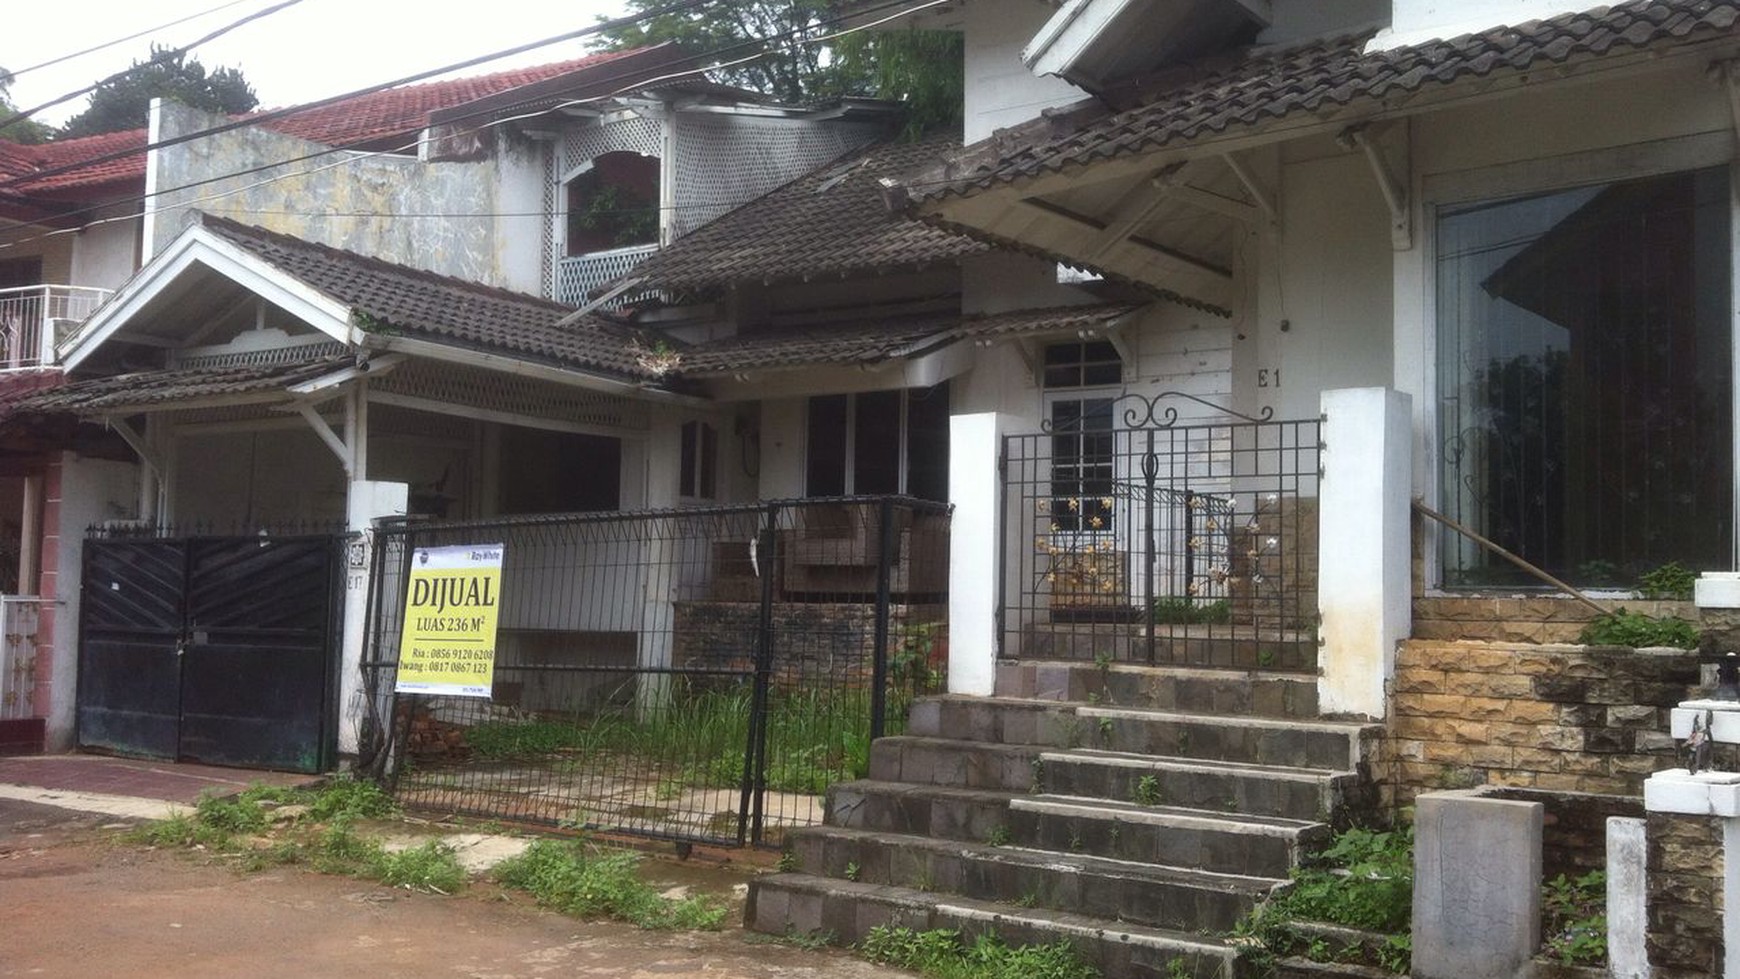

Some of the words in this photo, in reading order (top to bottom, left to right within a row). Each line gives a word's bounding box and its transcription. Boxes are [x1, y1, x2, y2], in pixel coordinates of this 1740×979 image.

[1258, 368, 1281, 388] E1
[411, 576, 495, 613] DIJUAL
[416, 617, 446, 632] LUAS
[447, 617, 469, 632] 236
[412, 647, 425, 659] Ria
[430, 648, 451, 660] 0856
[452, 648, 473, 660] 9120
[474, 649, 494, 661] 6208
[429, 661, 450, 673] 0817
[450, 662, 471, 674] 0867
[472, 662, 488, 674] 123
